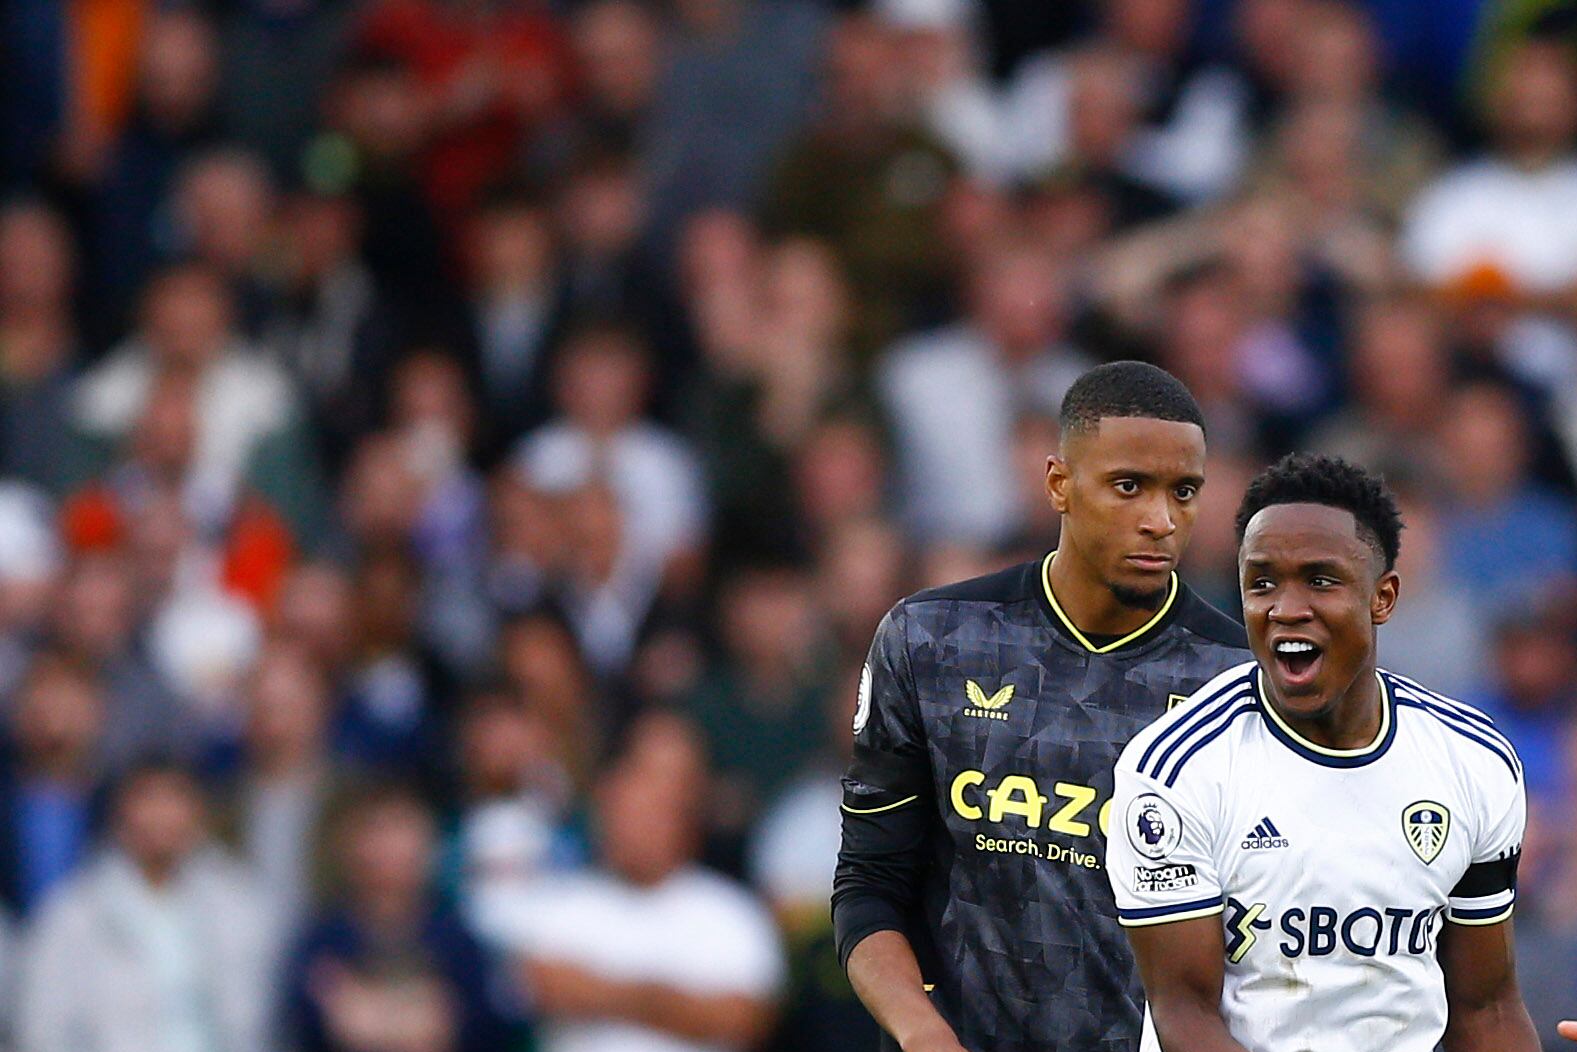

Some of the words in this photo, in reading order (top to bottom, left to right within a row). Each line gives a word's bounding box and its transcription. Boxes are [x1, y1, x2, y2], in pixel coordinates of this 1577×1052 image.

[950, 770, 1110, 837] CAZ
[975, 834, 1042, 858] Search.
[1047, 844, 1100, 869] Drive.
[1241, 837, 1289, 849] adidas
[1279, 906, 1436, 959] SBOTO
